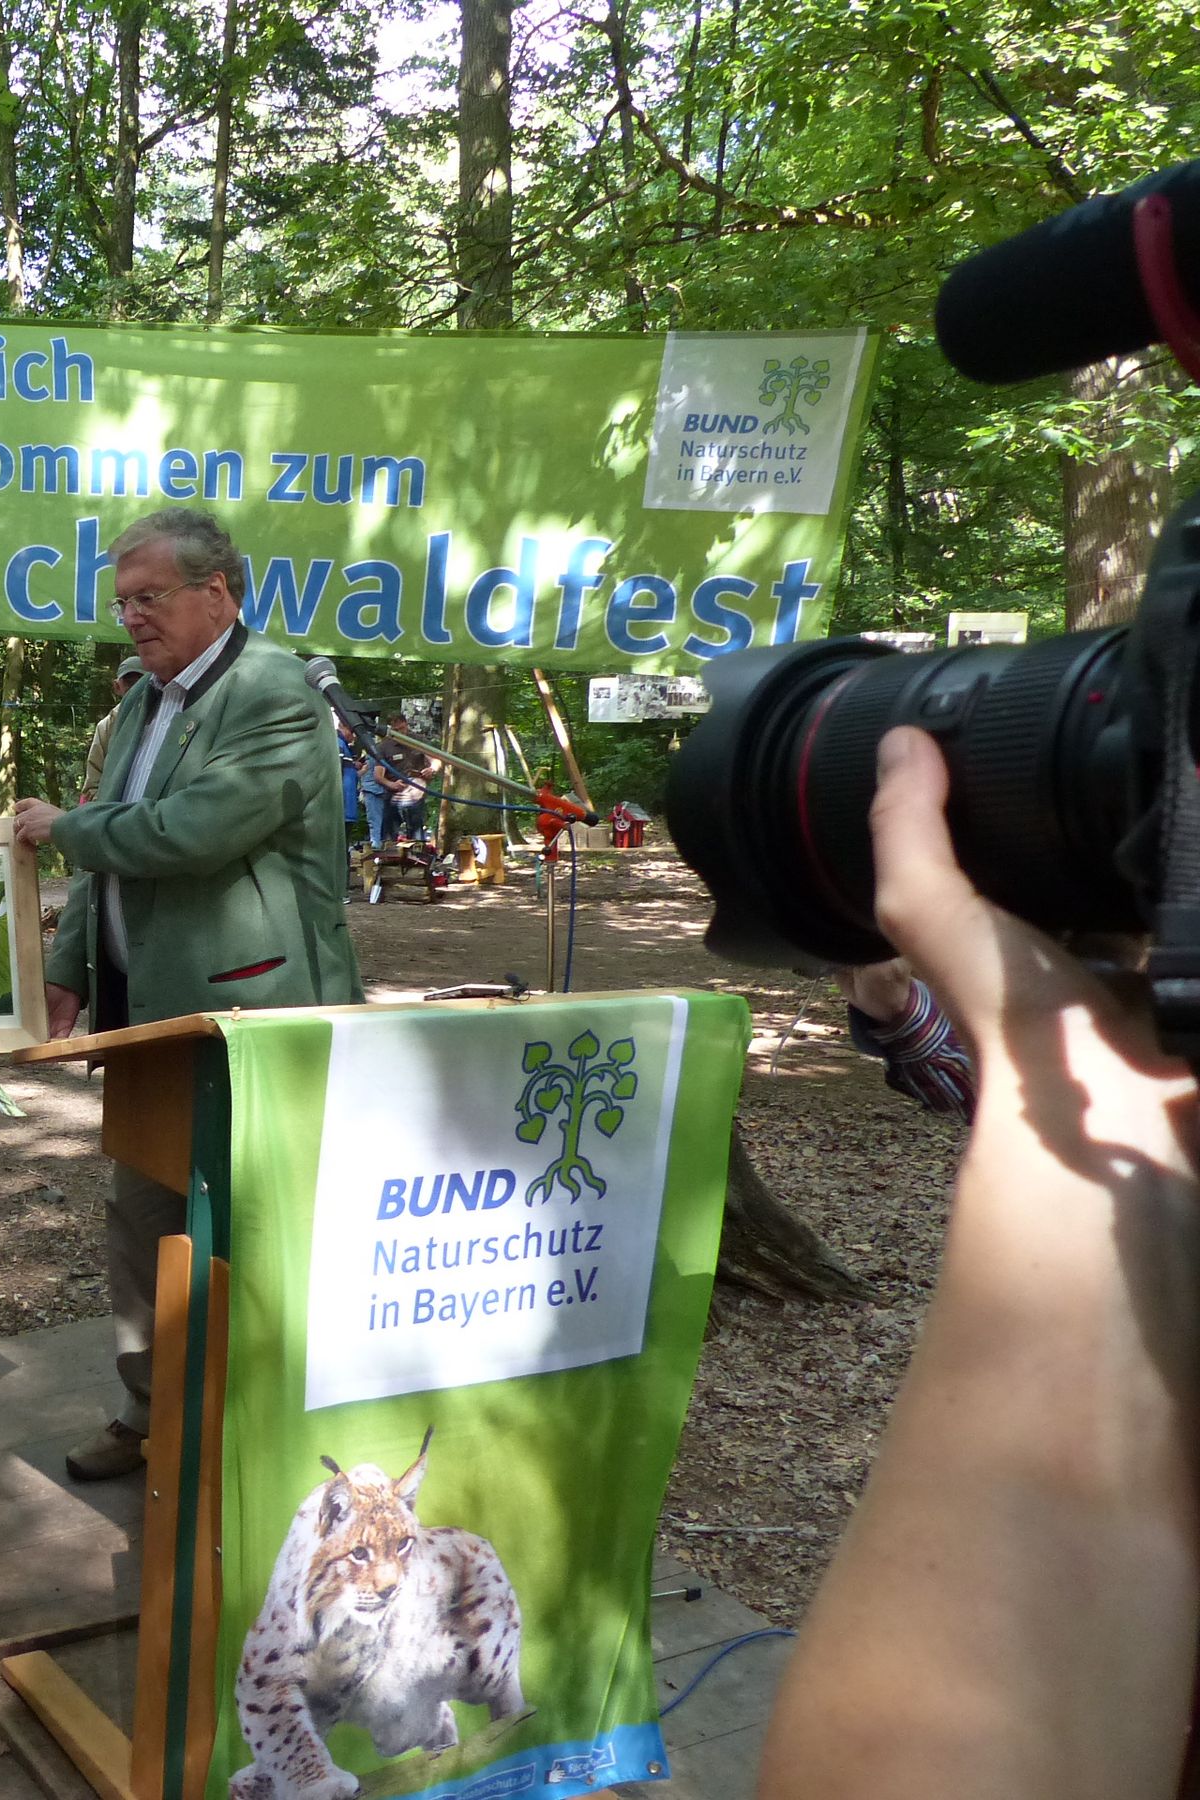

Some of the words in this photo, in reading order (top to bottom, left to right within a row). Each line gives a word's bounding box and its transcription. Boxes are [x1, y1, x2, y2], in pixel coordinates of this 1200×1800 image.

[683, 413, 759, 434] BUND
[677, 464, 695, 481] in
[701, 465, 769, 487] Bayern
[774, 467, 802, 484] e.V.
[680, 440, 808, 461] Naturschutz
[267, 452, 425, 508] zum
[376, 1168, 516, 1221] BUND
[373, 1220, 604, 1276] Naturschutz
[368, 1295, 400, 1331] in
[413, 1282, 536, 1330] Bayern
[546, 1266, 599, 1308] e.V.
